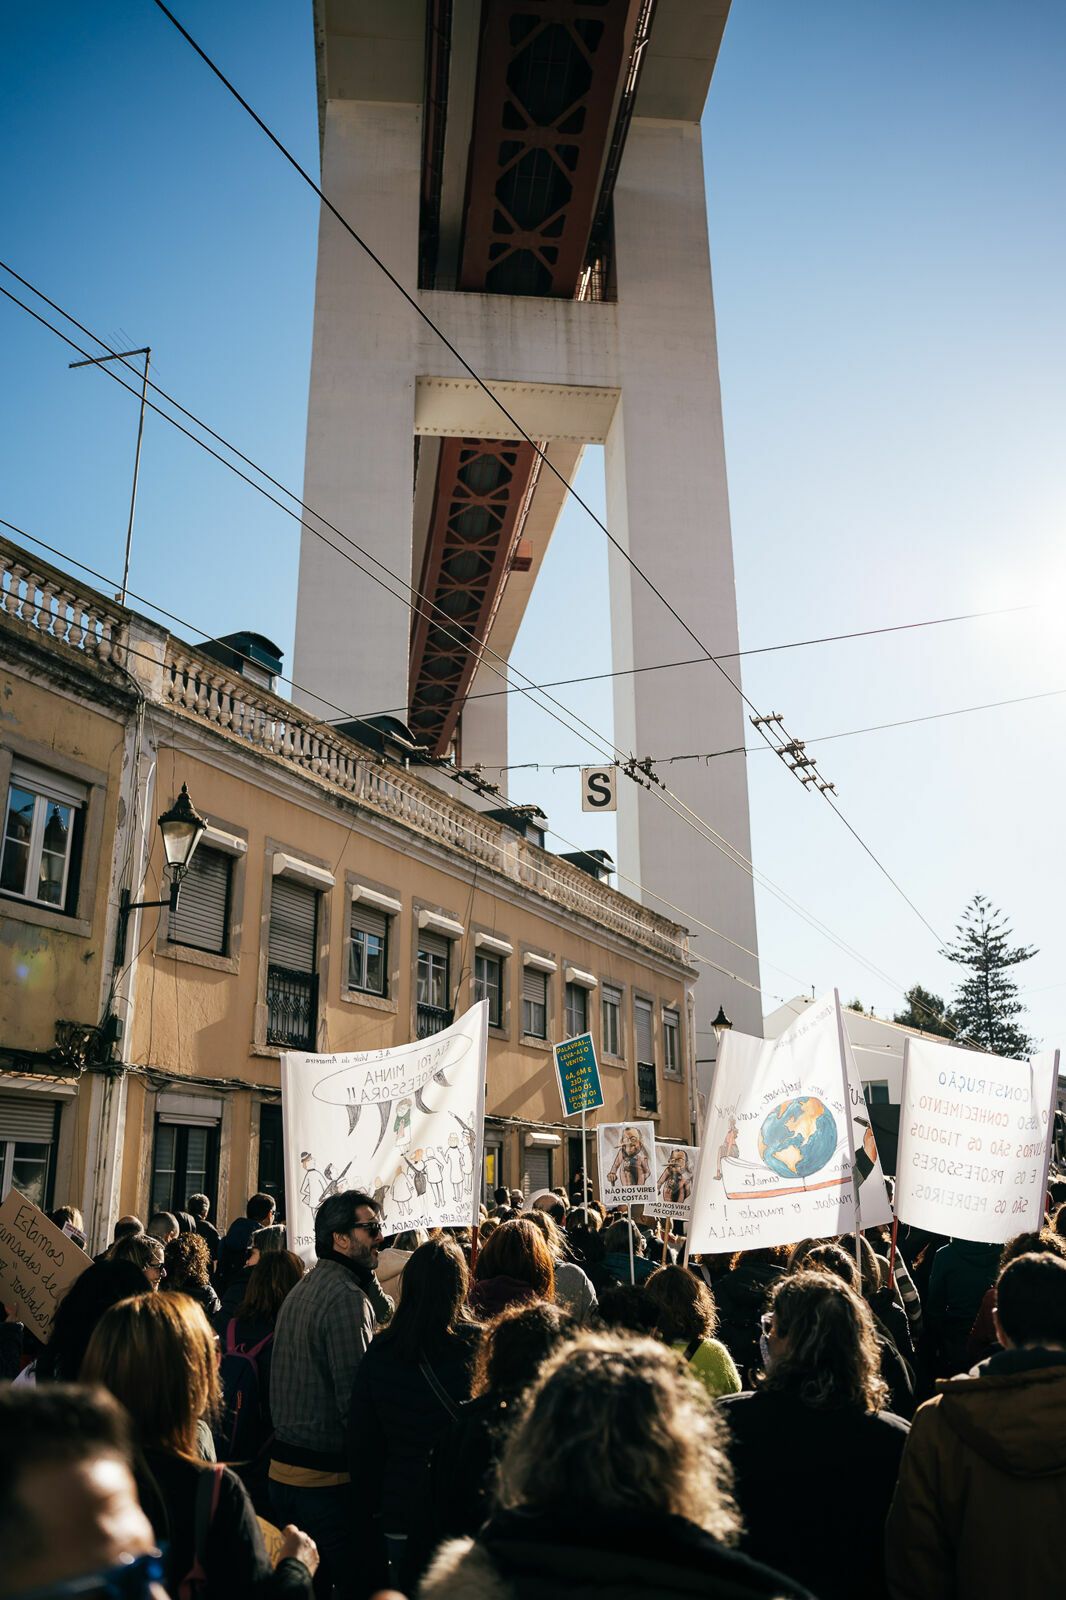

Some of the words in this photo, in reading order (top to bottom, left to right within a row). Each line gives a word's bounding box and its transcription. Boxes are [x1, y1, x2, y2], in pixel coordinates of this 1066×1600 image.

[587, 773, 611, 807] S
[556, 1040, 591, 1054] PALAVRAS...
[583, 1082, 592, 1090] OS
[588, 1089, 597, 1097] OS
[605, 1187, 620, 1195] NÃO
[621, 1186, 636, 1194] NOS
[636, 1186, 656, 1194] VIRES
[674, 1203, 691, 1211] VIRES
[13, 1205, 64, 1267] Estamos
[41, 1272, 58, 1300] de
